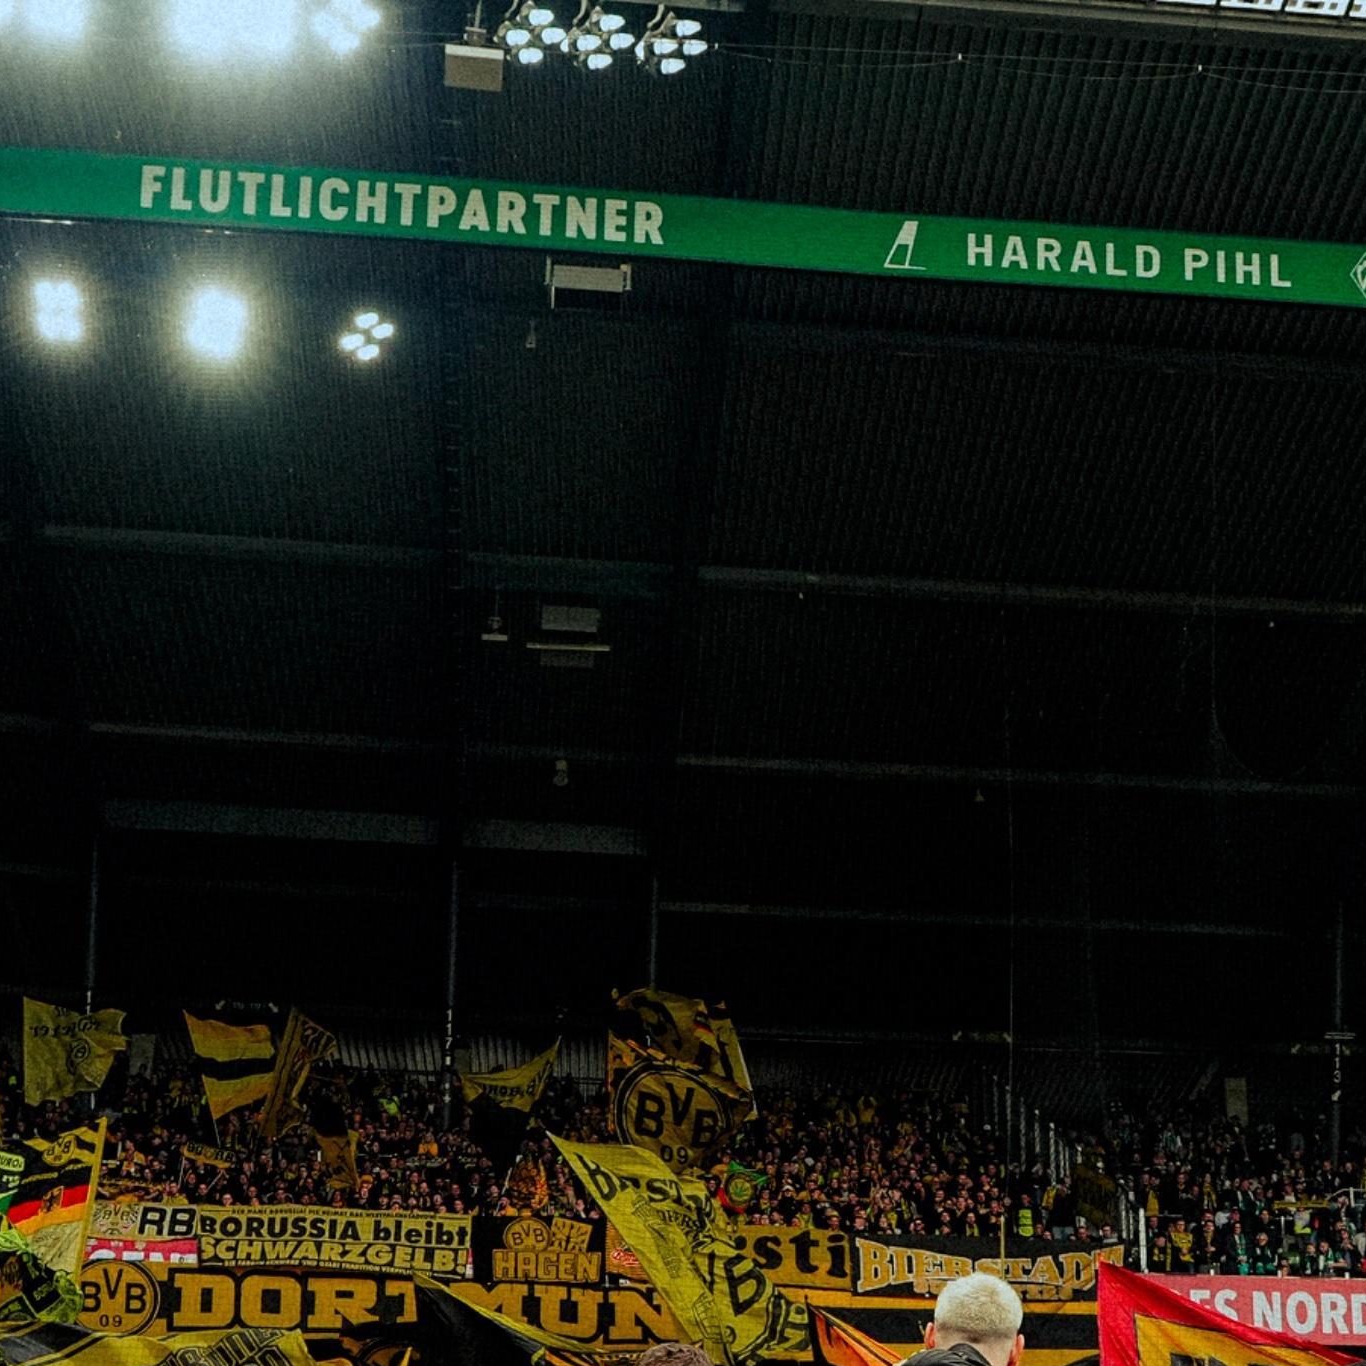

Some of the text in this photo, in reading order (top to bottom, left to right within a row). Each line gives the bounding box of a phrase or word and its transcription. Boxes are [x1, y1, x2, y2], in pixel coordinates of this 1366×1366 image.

[139, 164, 666, 246] FLUTLICHTPARTNER
[965, 231, 1292, 289] HARALD PIHL
[660, 1145, 688, 1164] 09
[138, 1206, 196, 1236] RB
[200, 1214, 468, 1246] BORUSSIA bleibt
[201, 1236, 467, 1274] SCHWARZGELB!
[495, 1251, 600, 1281] HAGEN
[80, 1269, 147, 1313] BVB
[99, 1315, 122, 1327] 09
